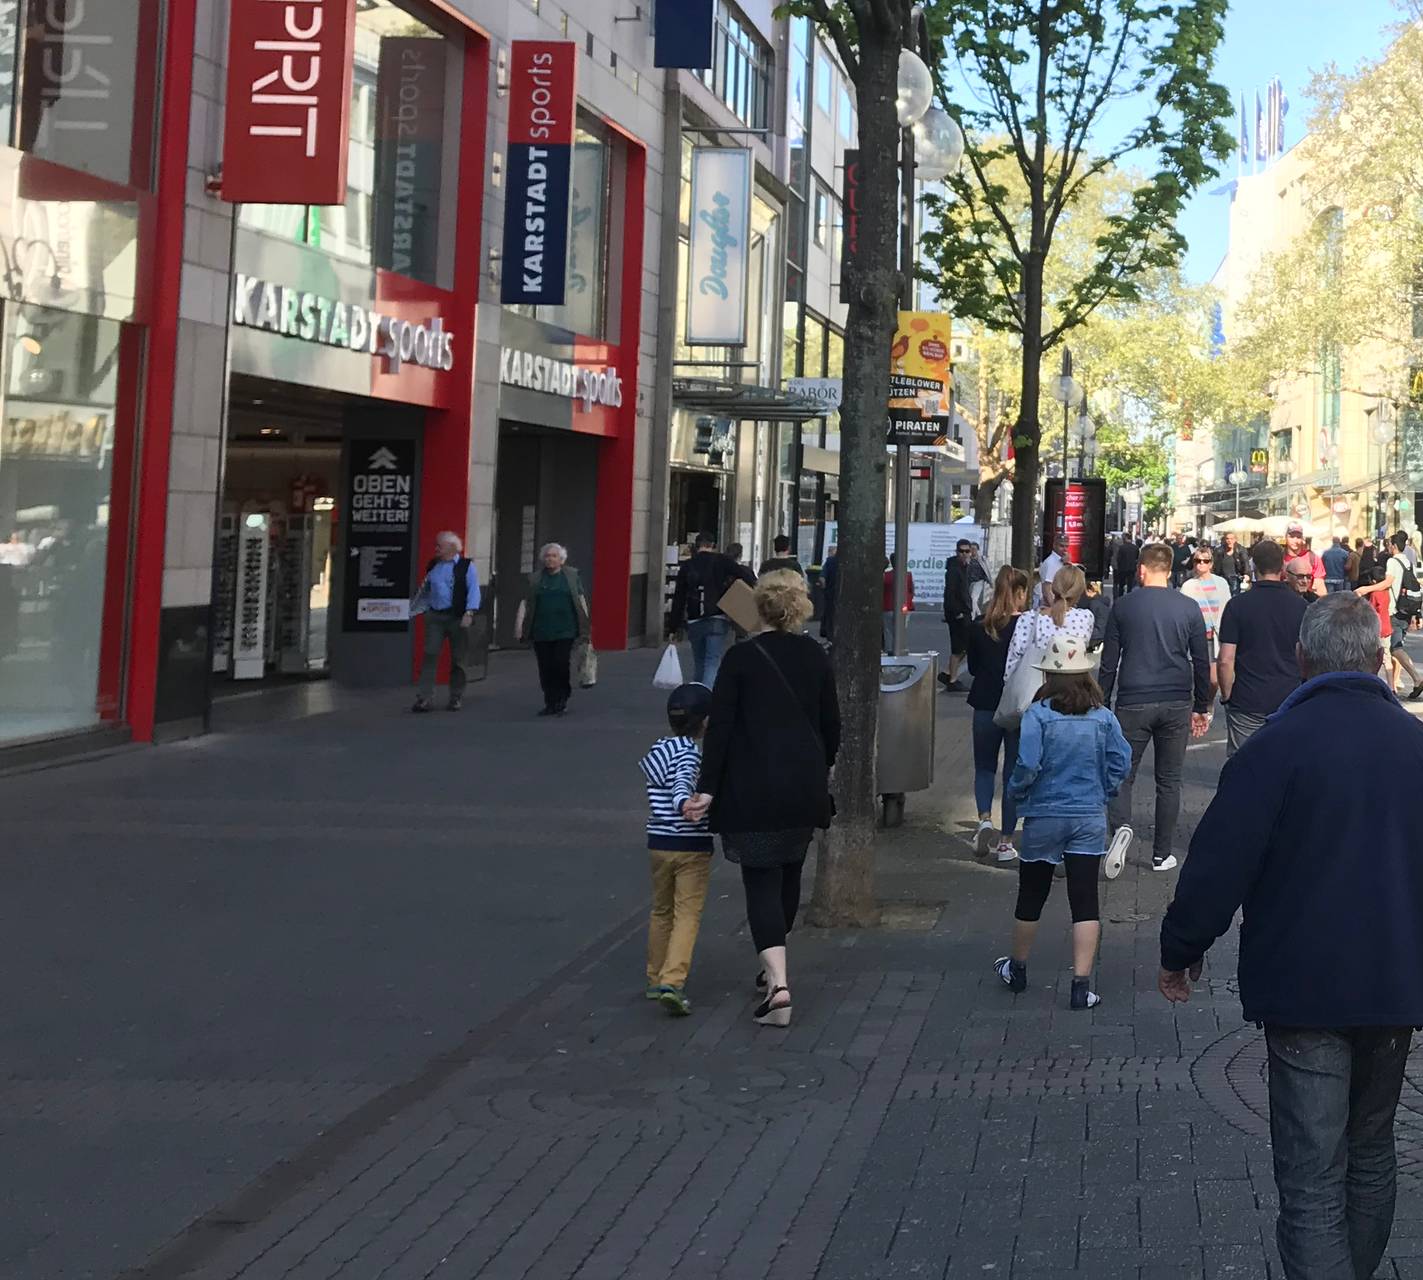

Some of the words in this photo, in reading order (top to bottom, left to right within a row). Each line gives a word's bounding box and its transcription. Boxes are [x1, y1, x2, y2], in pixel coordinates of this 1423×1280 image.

[250, 0, 323, 157] PRIT
[527, 52, 557, 139] sports
[522, 146, 549, 293] KARSTADT
[235, 272, 382, 354] KARSTADT
[380, 317, 454, 375] sports
[500, 346, 580, 398] KARSTADT
[580, 367, 623, 413] sports
[890, 375, 941, 389] TLEBLOWER
[895, 420, 940, 432] PIRATEN
[352, 494, 410, 509] GEHT'S
[353, 474, 411, 493] OBEN
[351, 509, 409, 523] WEITER!
